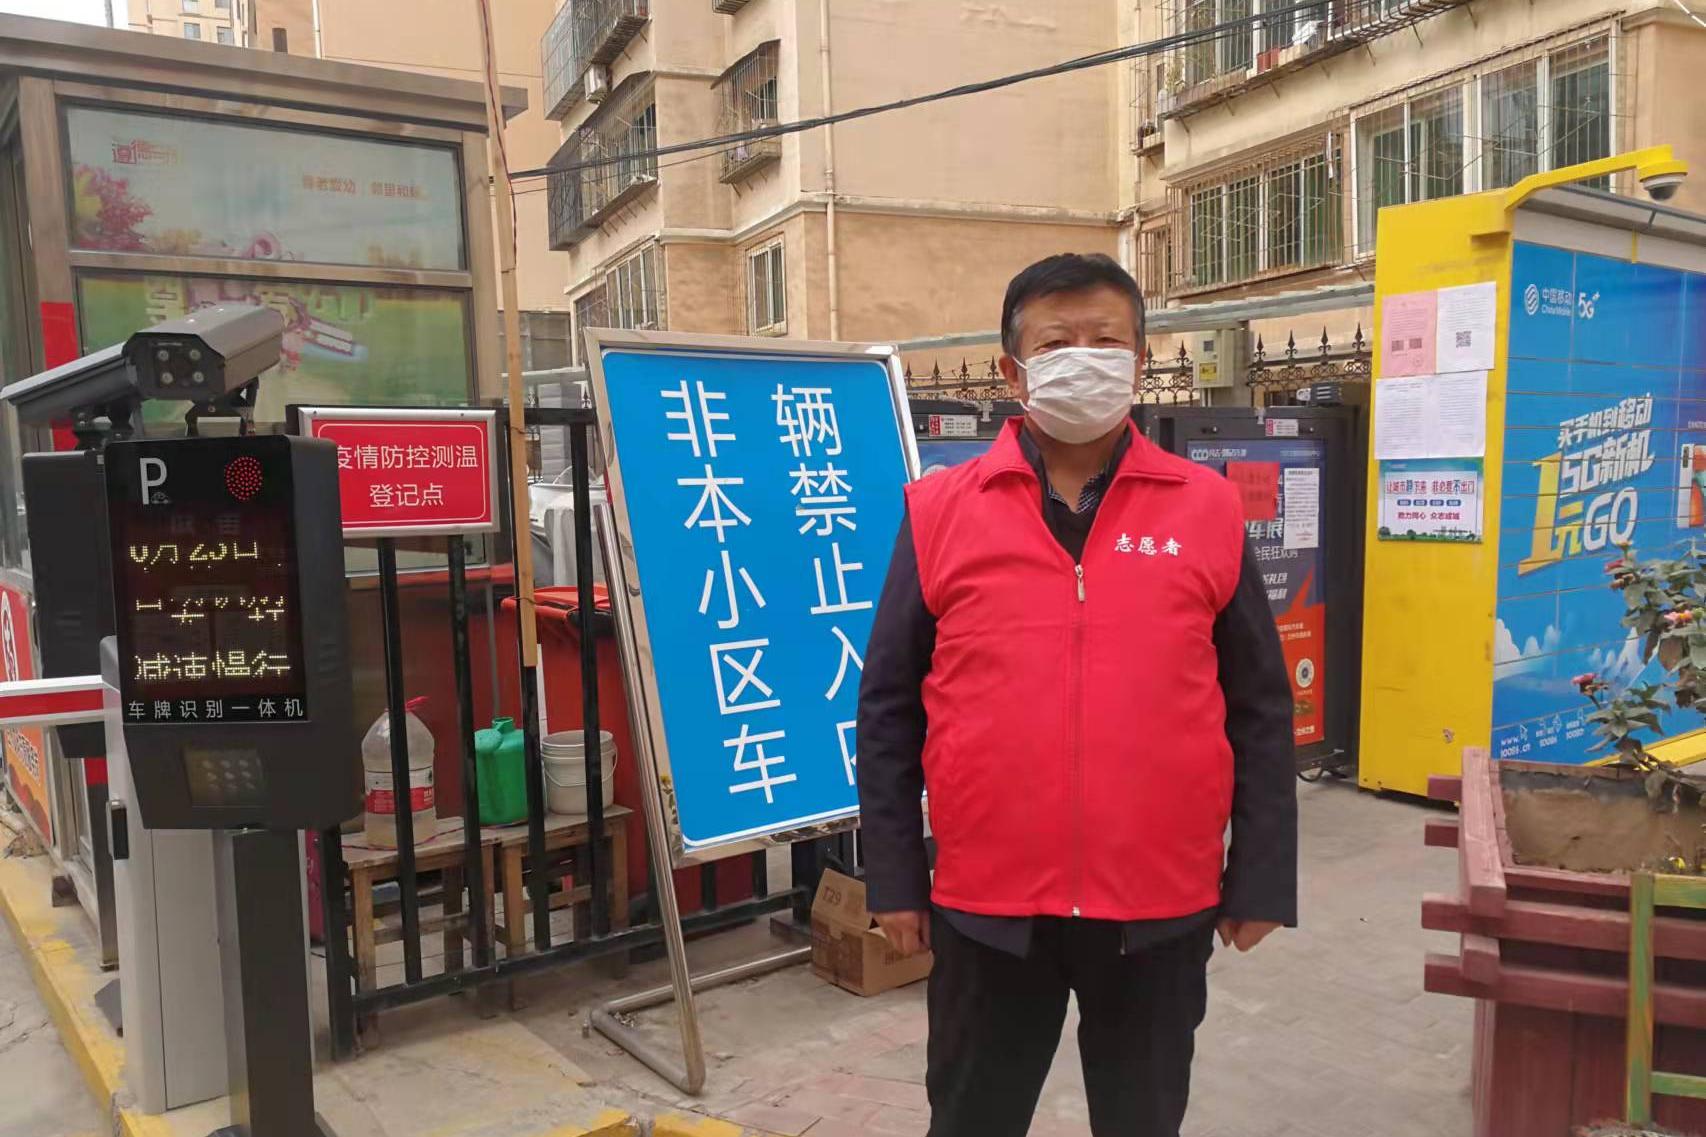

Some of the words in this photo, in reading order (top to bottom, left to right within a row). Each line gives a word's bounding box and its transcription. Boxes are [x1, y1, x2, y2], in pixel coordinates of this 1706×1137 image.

[1541, 288, 1573, 305] 中国移动
[1558, 392, 1654, 448] 买手机到移动
[337, 444, 478, 470] 疫情防控测温
[1559, 429, 1656, 498] 5G新机
[139, 457, 168, 505] P
[369, 482, 444, 508] 登记点
[1114, 533, 1182, 557] 志愿者
[661, 380, 797, 804] 非本小区车
[128, 698, 304, 720] 车牌识别一体机
